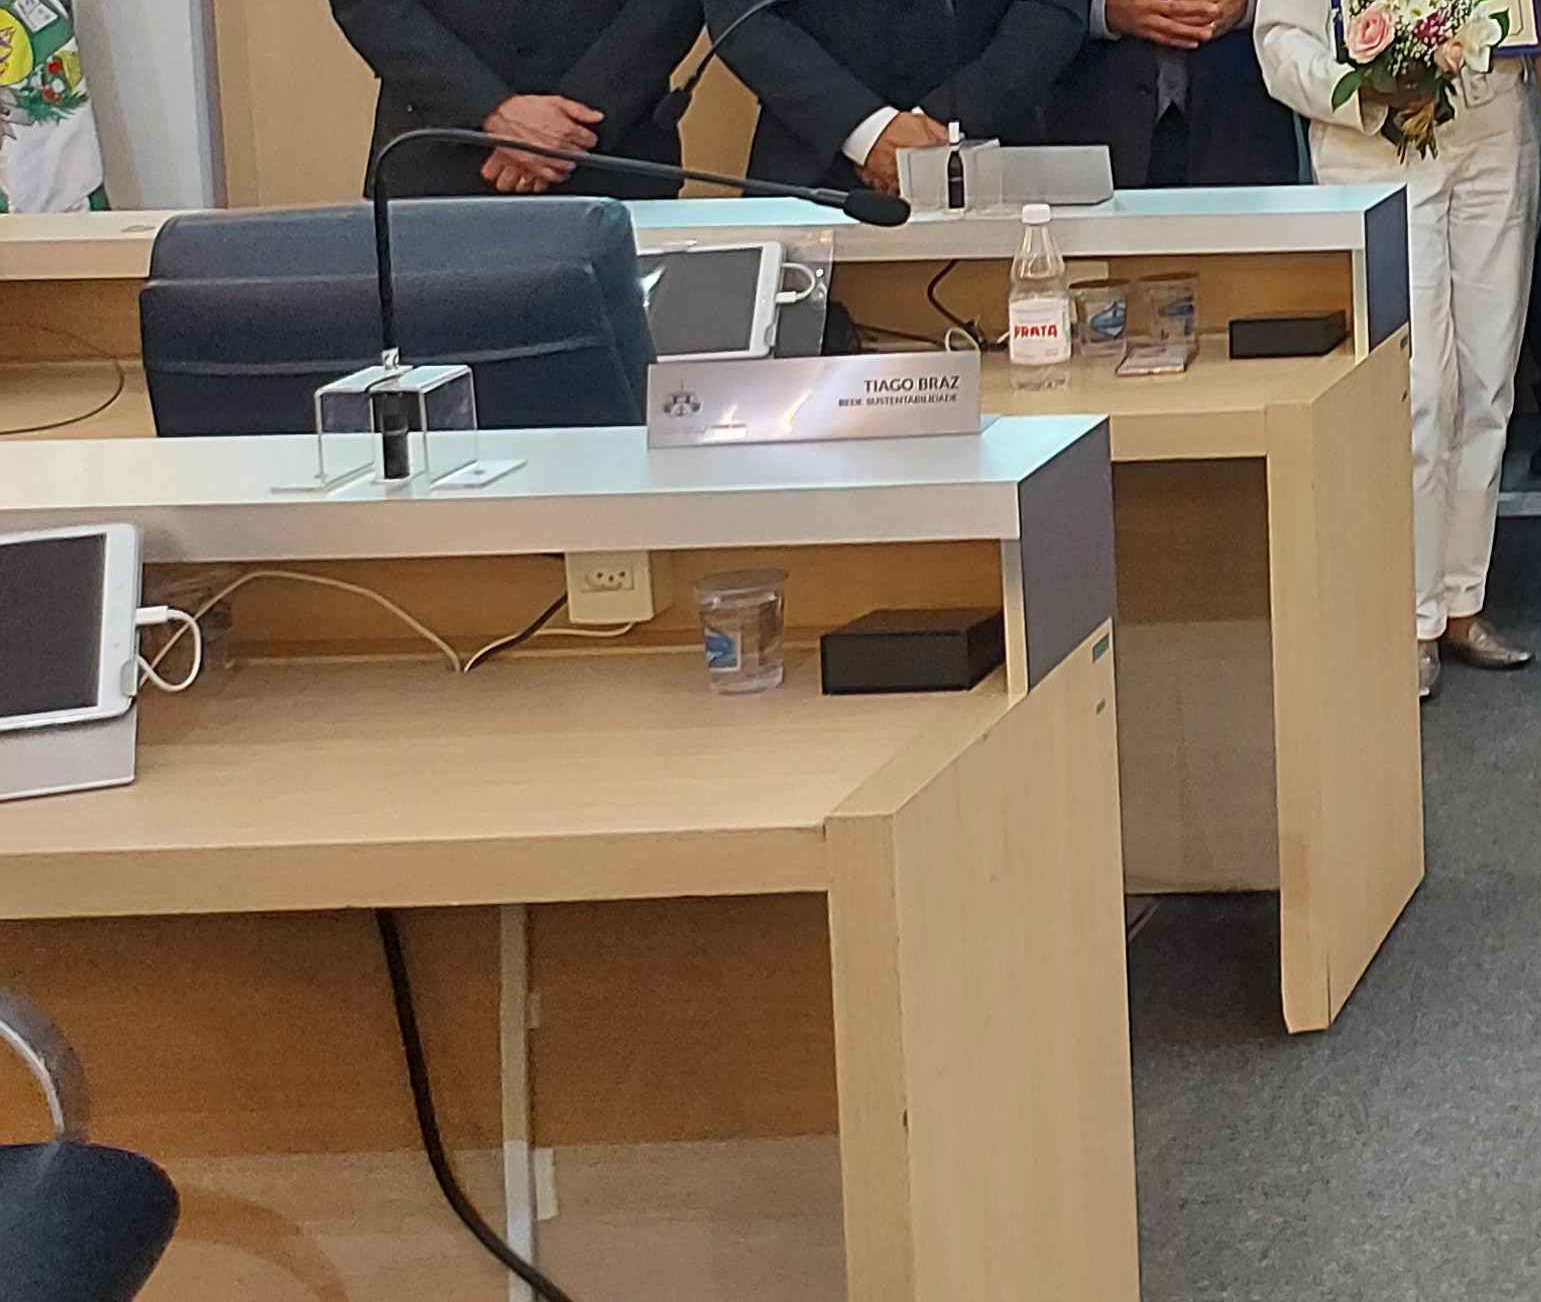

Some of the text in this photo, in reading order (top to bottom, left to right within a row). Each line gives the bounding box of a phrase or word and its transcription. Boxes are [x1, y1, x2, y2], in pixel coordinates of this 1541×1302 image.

[1013, 323, 1058, 339] PRATA
[863, 375, 960, 393] TIAGO BRAZ
[866, 393, 957, 406] SUSTENTABILIDADE
